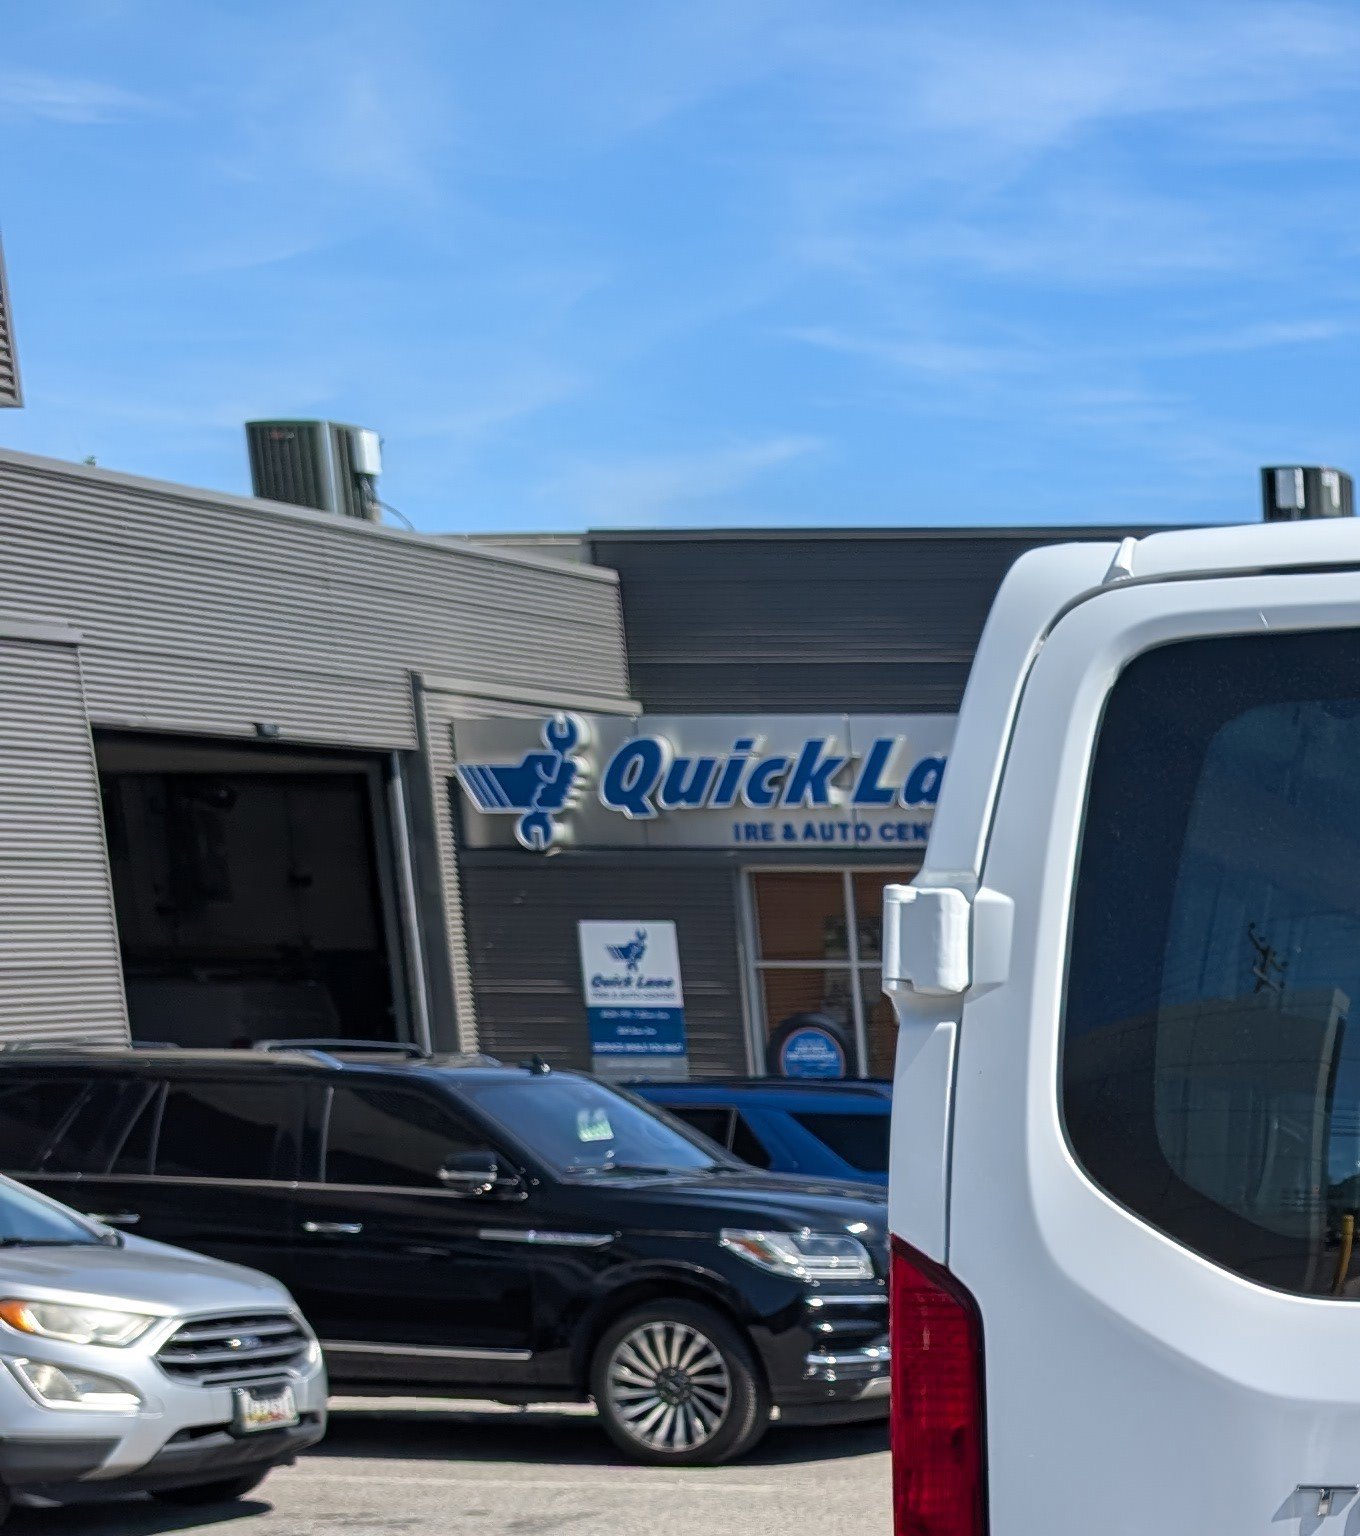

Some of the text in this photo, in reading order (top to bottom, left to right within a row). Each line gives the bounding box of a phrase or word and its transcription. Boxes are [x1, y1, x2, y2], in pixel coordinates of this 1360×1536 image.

[602, 737, 848, 818] Quick
[733, 821, 773, 842] IRE
[782, 822, 798, 842] &
[803, 821, 872, 842] AUTO
